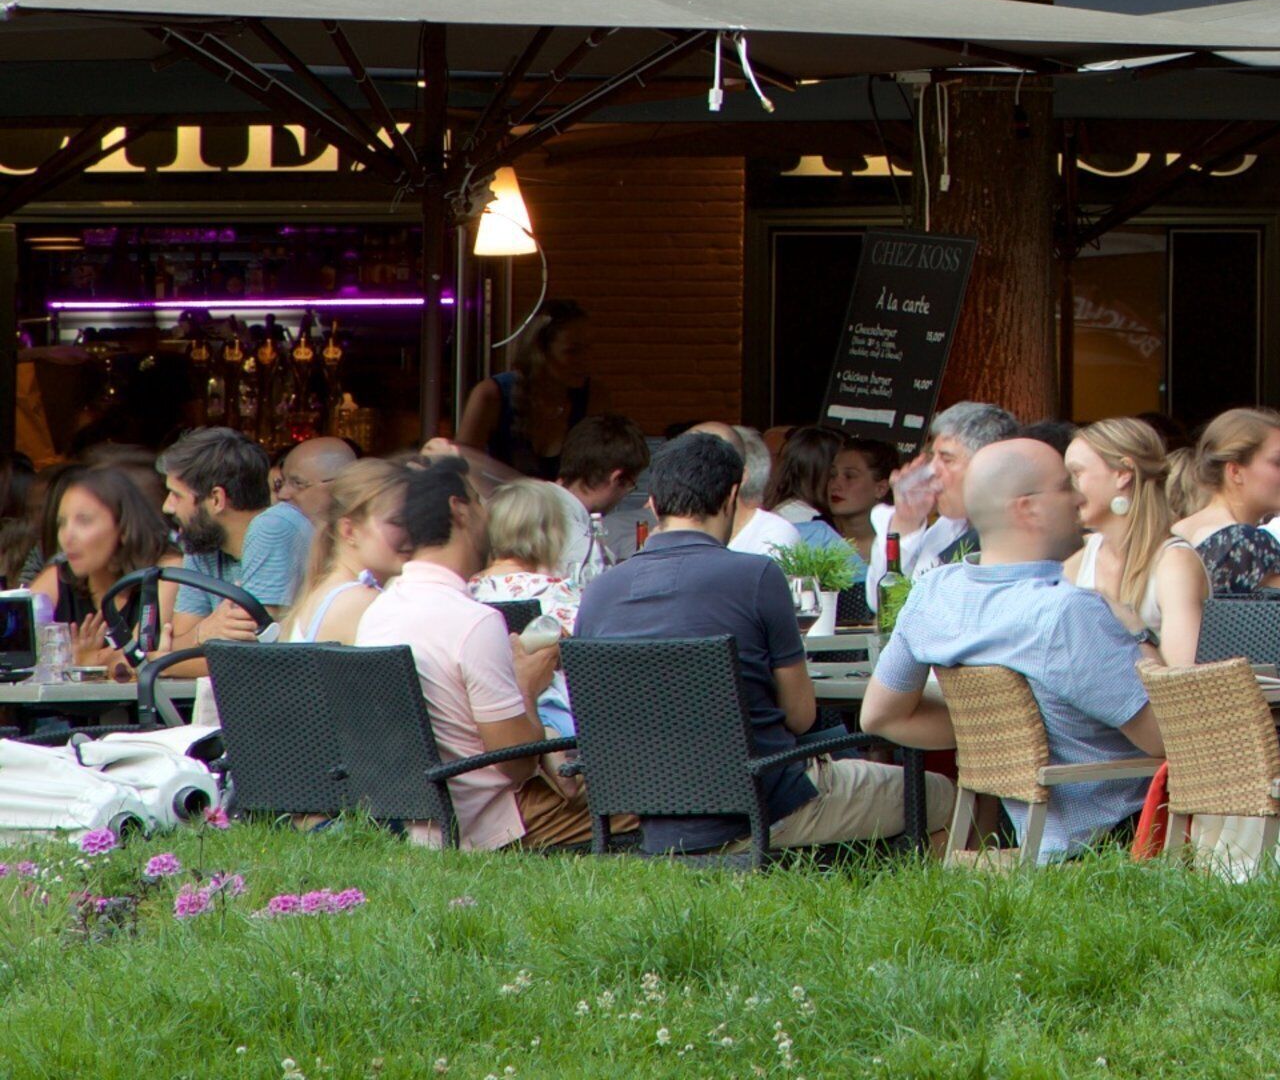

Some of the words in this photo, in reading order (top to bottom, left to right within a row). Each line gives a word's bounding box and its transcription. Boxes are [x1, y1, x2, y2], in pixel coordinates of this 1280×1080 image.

[871, 240, 918, 268] CHEZ
[918, 244, 963, 272] KOSS
[902, 295, 931, 315] carte
